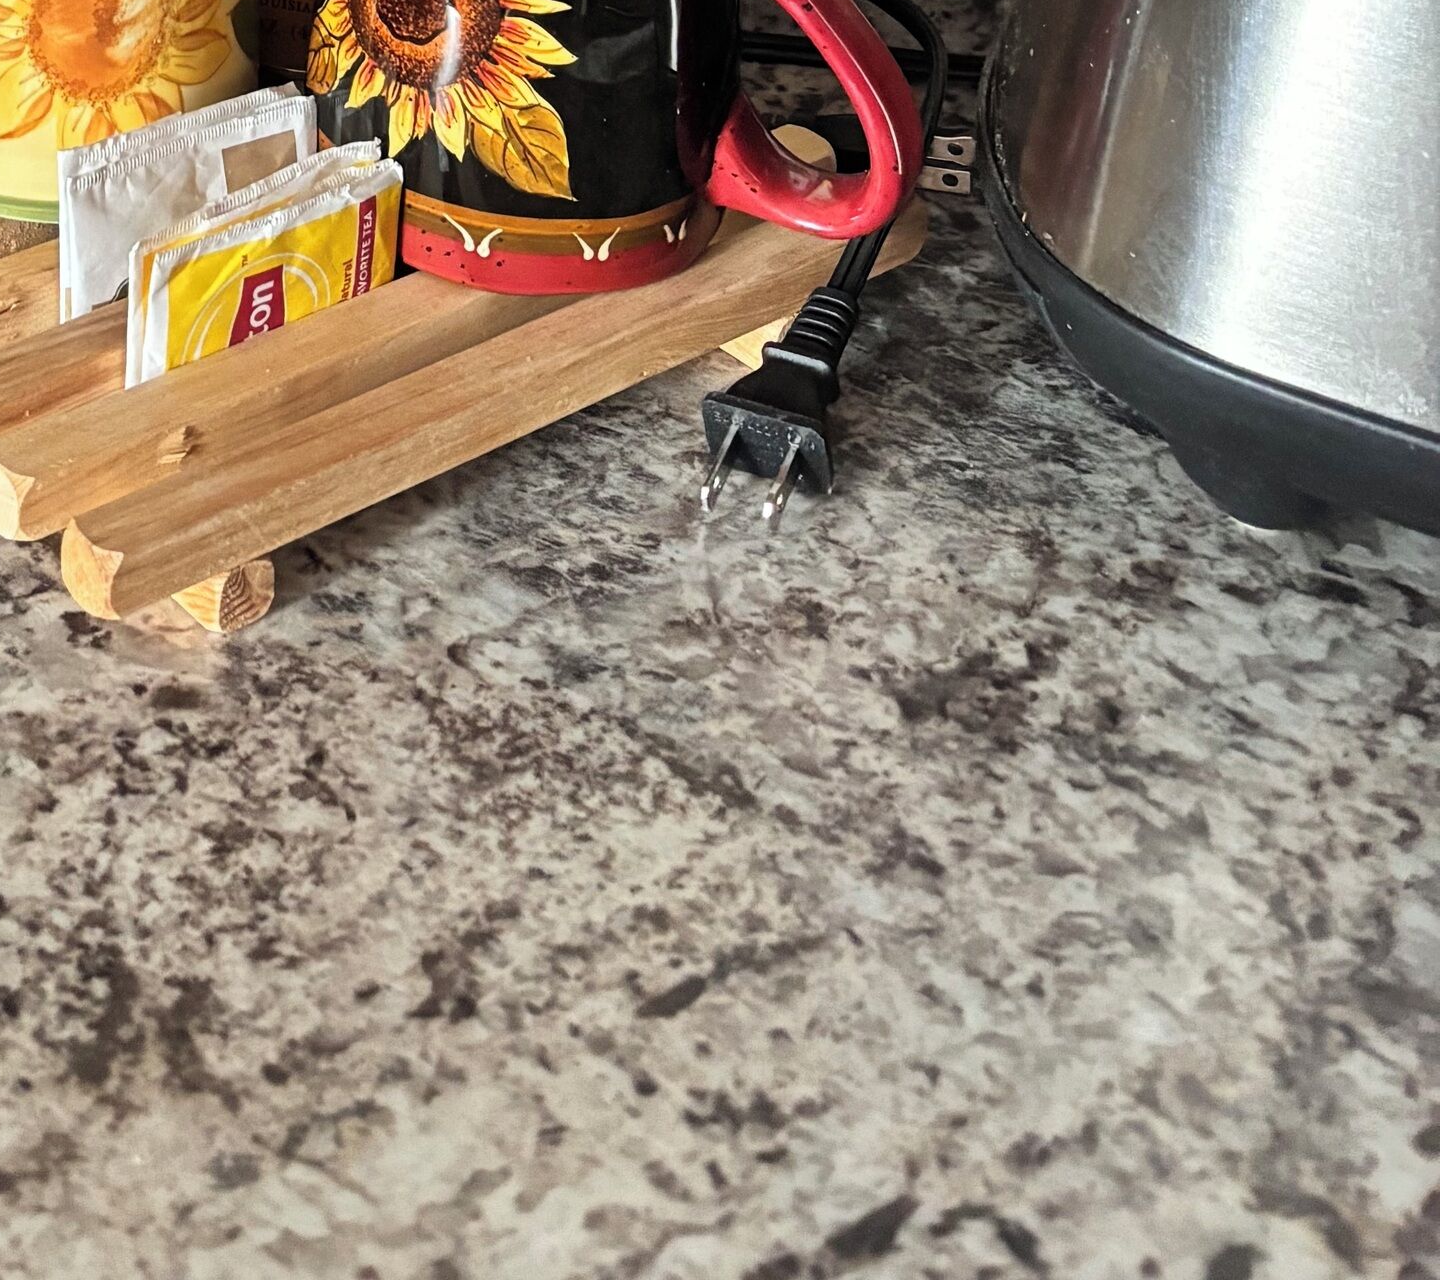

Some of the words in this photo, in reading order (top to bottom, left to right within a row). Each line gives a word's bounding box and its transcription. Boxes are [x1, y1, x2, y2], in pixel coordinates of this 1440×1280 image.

[363, 210, 373, 235] TEA
[341, 258, 353, 301] atural
[357, 239, 371, 296] VORITE
